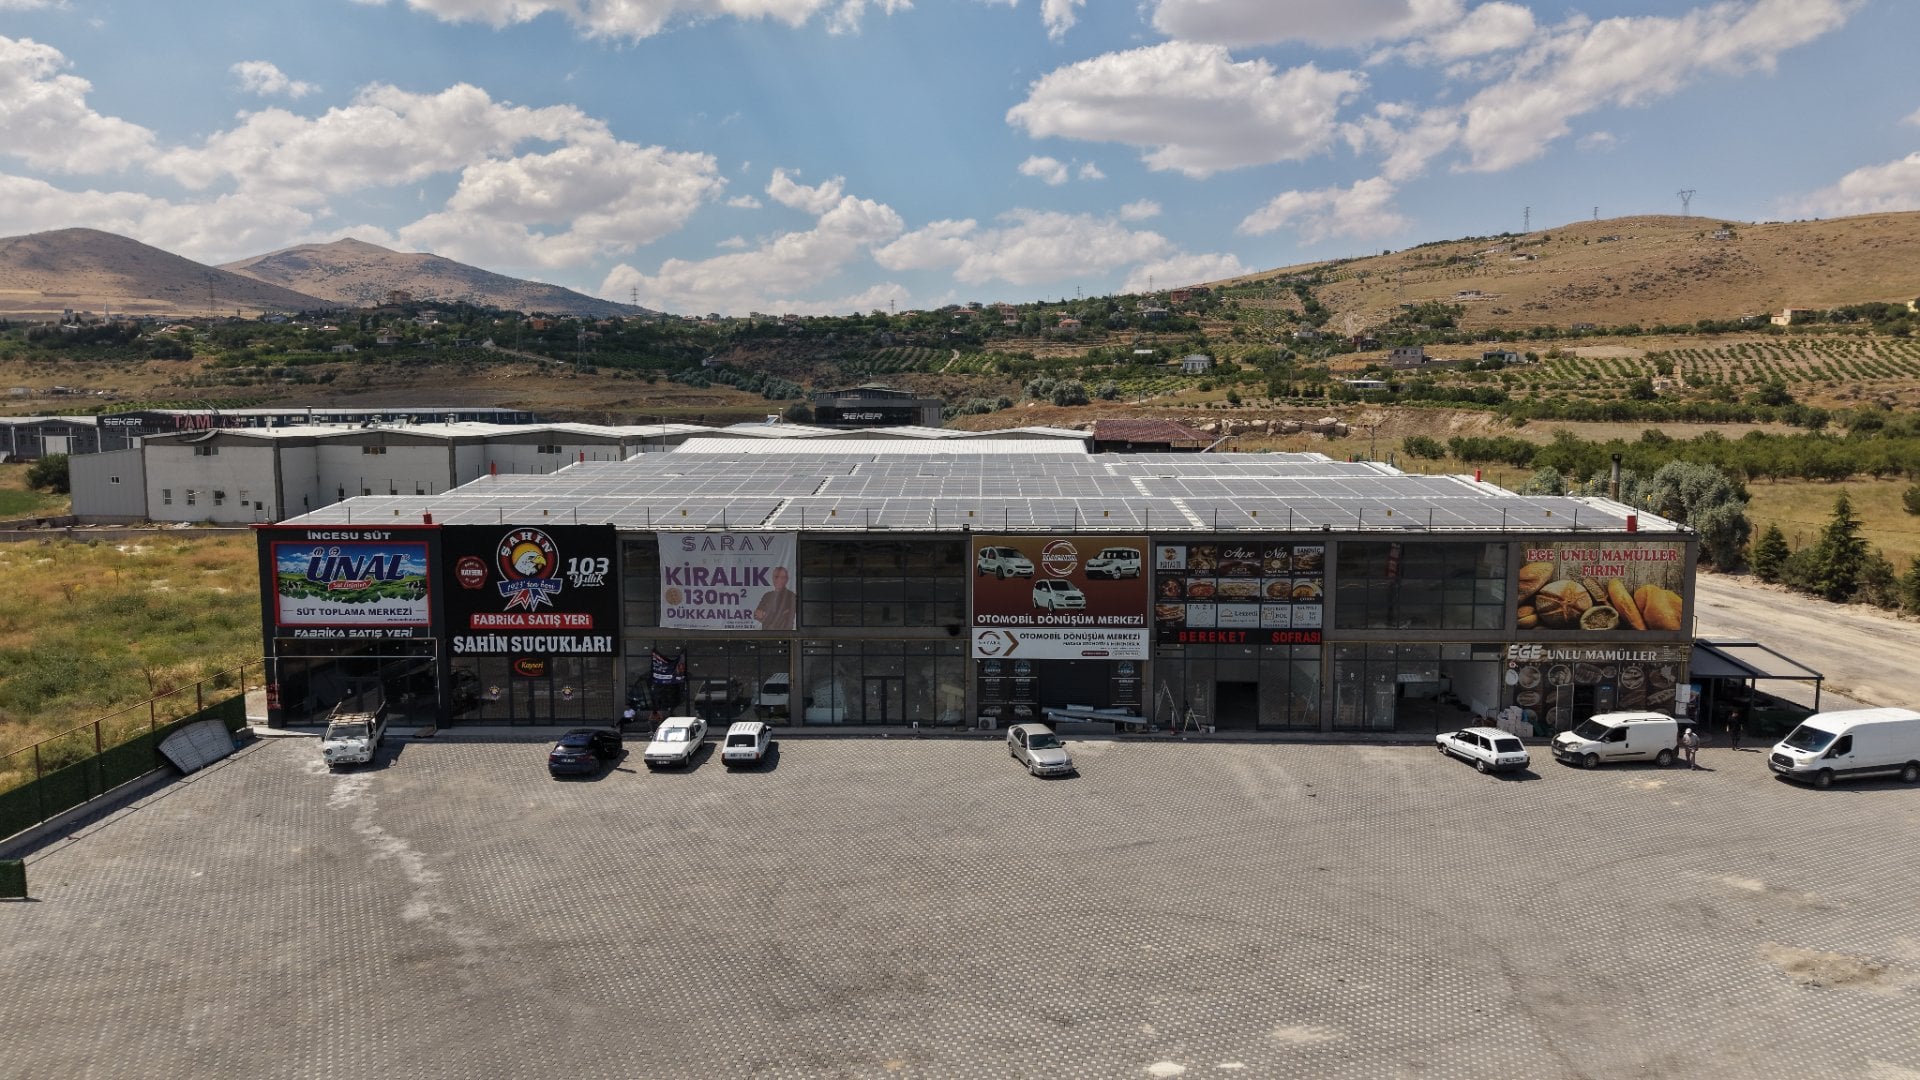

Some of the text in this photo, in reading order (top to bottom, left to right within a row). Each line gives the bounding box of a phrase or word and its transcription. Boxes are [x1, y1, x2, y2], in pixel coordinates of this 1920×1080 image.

[307, 530, 391, 540] İNCESU SÜT
[501, 531, 553, 557] ŞAHİN
[682, 535, 775, 552] SARAY
[1527, 547, 1678, 561] EGE UNLU MAMÜLLER
[306, 546, 406, 583] ÜNAL
[567, 557, 609, 575] 103
[665, 562, 770, 587] KİRALIK
[684, 588, 747, 606] 130m²
[296, 607, 413, 616] SÜT TOPLAMA MERKEZİ
[667, 606, 753, 620] DÜKKANLAR
[528, 615, 561, 628] SATIŞ
[977, 613, 1144, 626] OTOMOBİL DÖNÜŞÜM MERKEZİ
[294, 627, 413, 639] FABRİKA SATIŞ YERİ
[1019, 632, 1141, 643] OTOMOBİL DÖNÜŞÜM MERKEZİ
[1179, 632, 1321, 643] BEREKET SOFRASI
[453, 633, 612, 653] ŞAHİN SUCUKLARI
[1507, 645, 1543, 660] EGE
[1547, 650, 1581, 660] UNLU
[1585, 648, 1657, 661] MAMÜLLER
